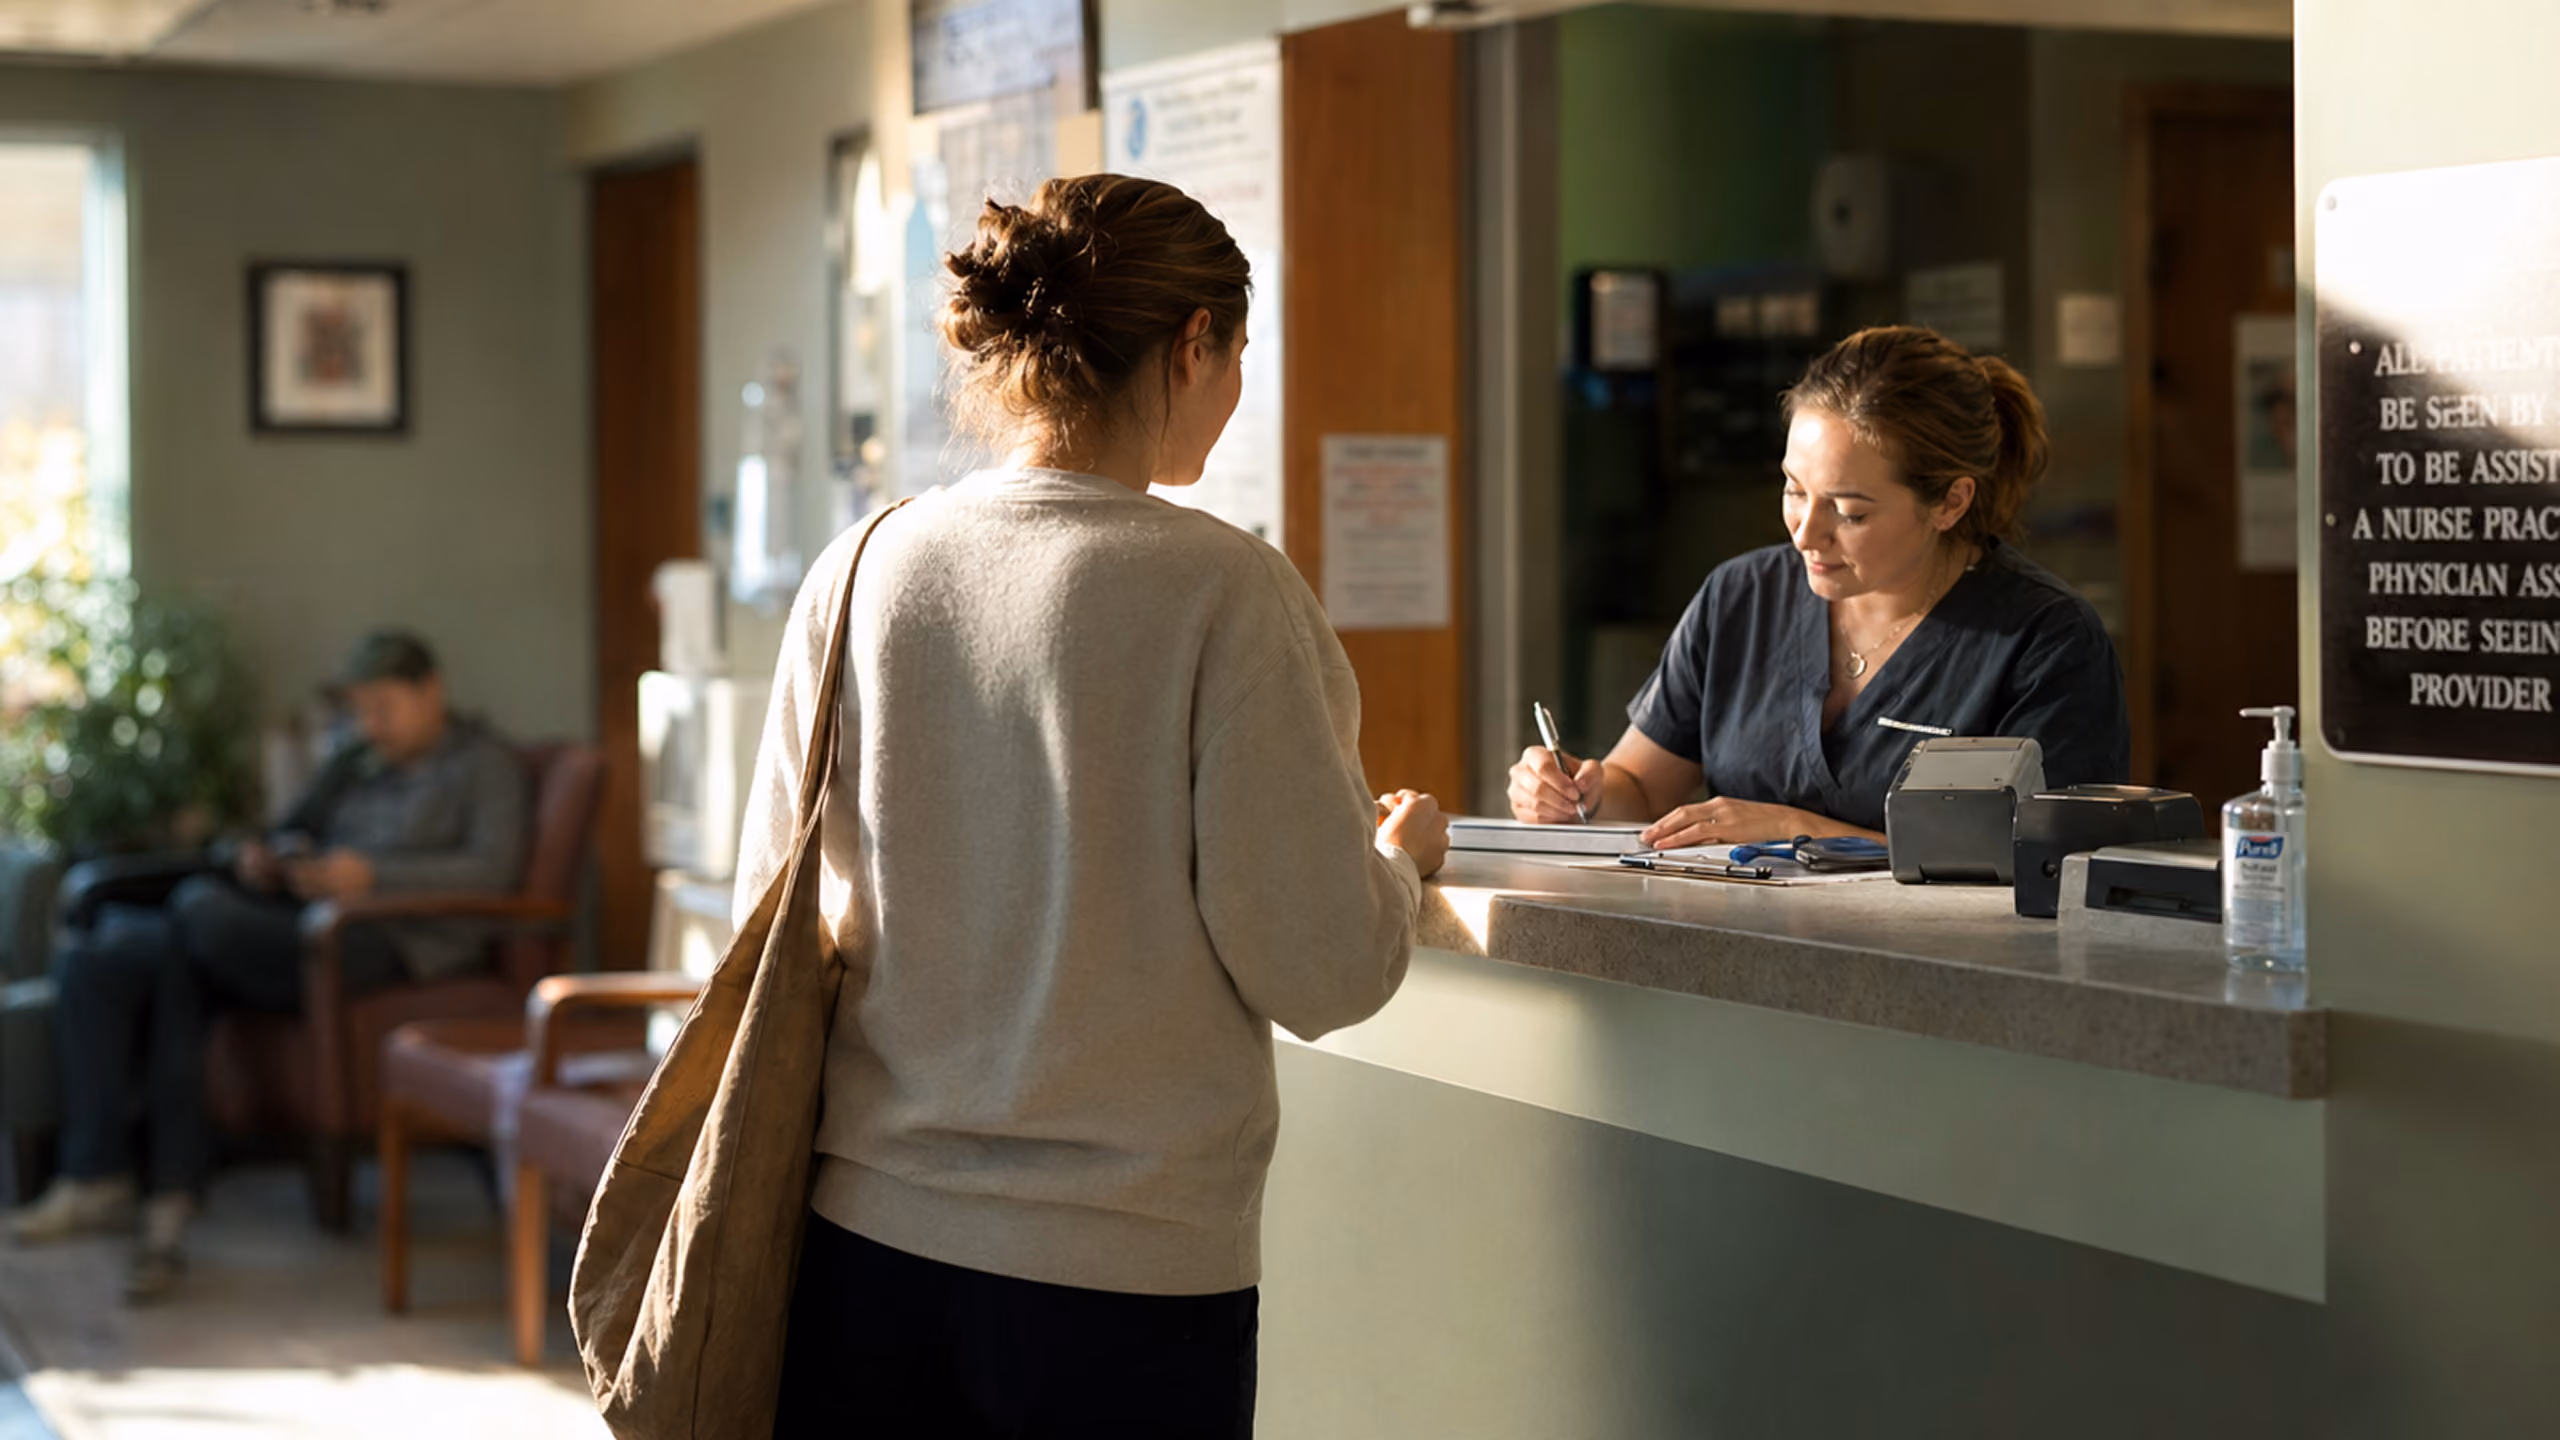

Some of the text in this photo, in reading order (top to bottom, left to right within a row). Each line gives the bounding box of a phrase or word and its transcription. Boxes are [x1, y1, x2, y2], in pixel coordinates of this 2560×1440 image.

[2380, 397, 2417, 430] BE
[2510, 391, 2546, 427] BY
[2376, 449, 2560, 484] TO BE ASSIST
[2352, 508, 2373, 540] A
[2382, 507, 2473, 541] NURSE
[2369, 562, 2508, 597] PHYSICIAN
[2366, 616, 2471, 652] BEFORE
[2410, 672, 2552, 713] PROVIDER
